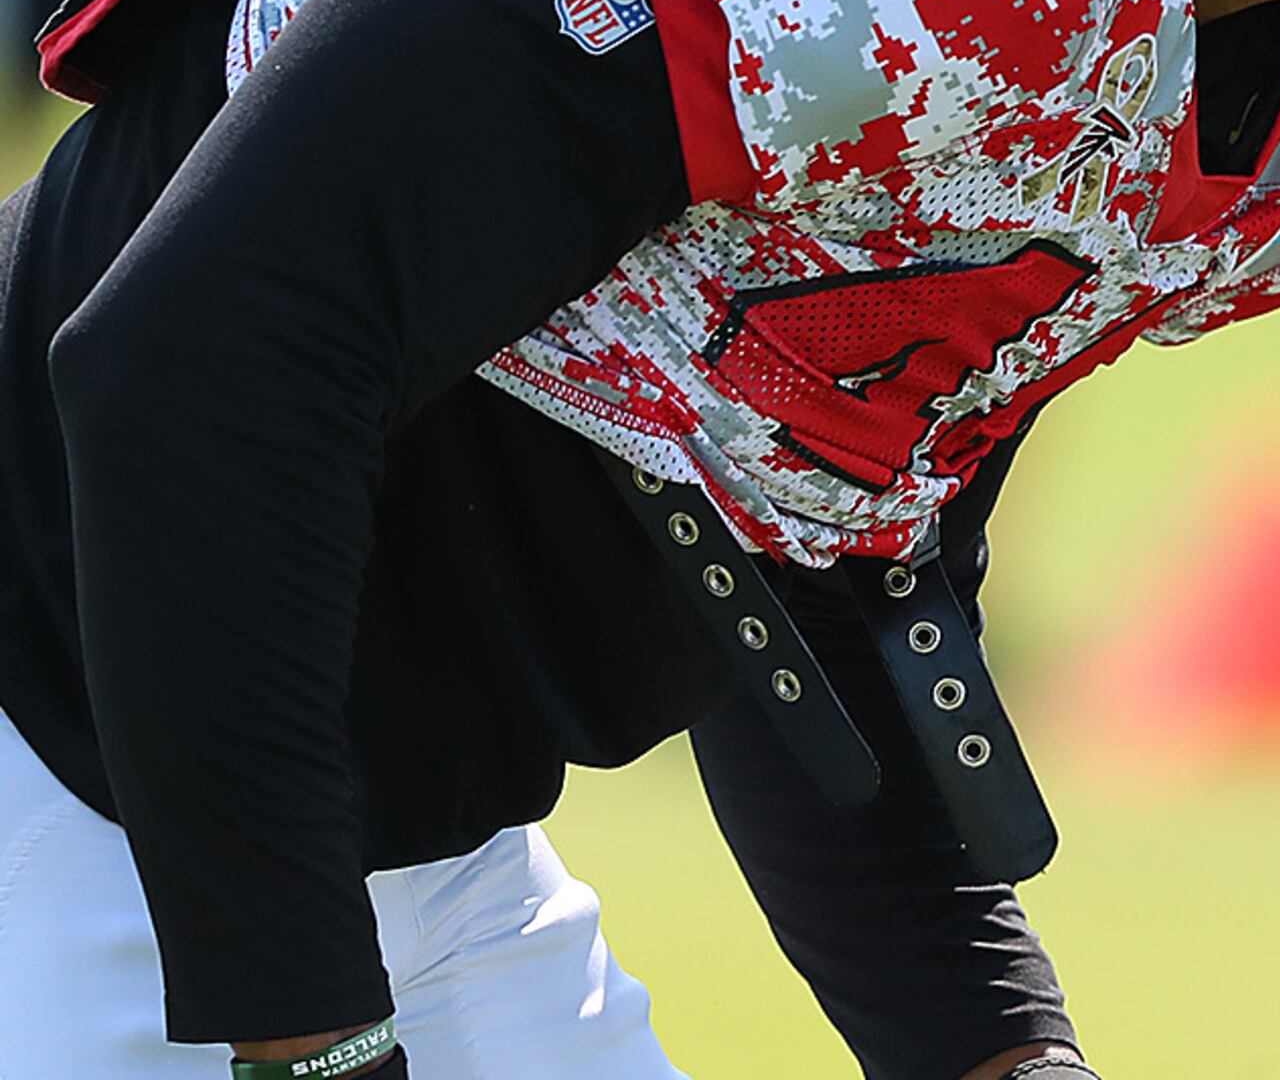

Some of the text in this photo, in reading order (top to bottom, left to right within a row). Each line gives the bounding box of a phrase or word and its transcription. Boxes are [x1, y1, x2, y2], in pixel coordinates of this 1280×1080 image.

[702, 238, 1195, 493] 4
[291, 1026, 389, 1077] FALCONS
[322, 1048, 378, 1078] ATLANTA
